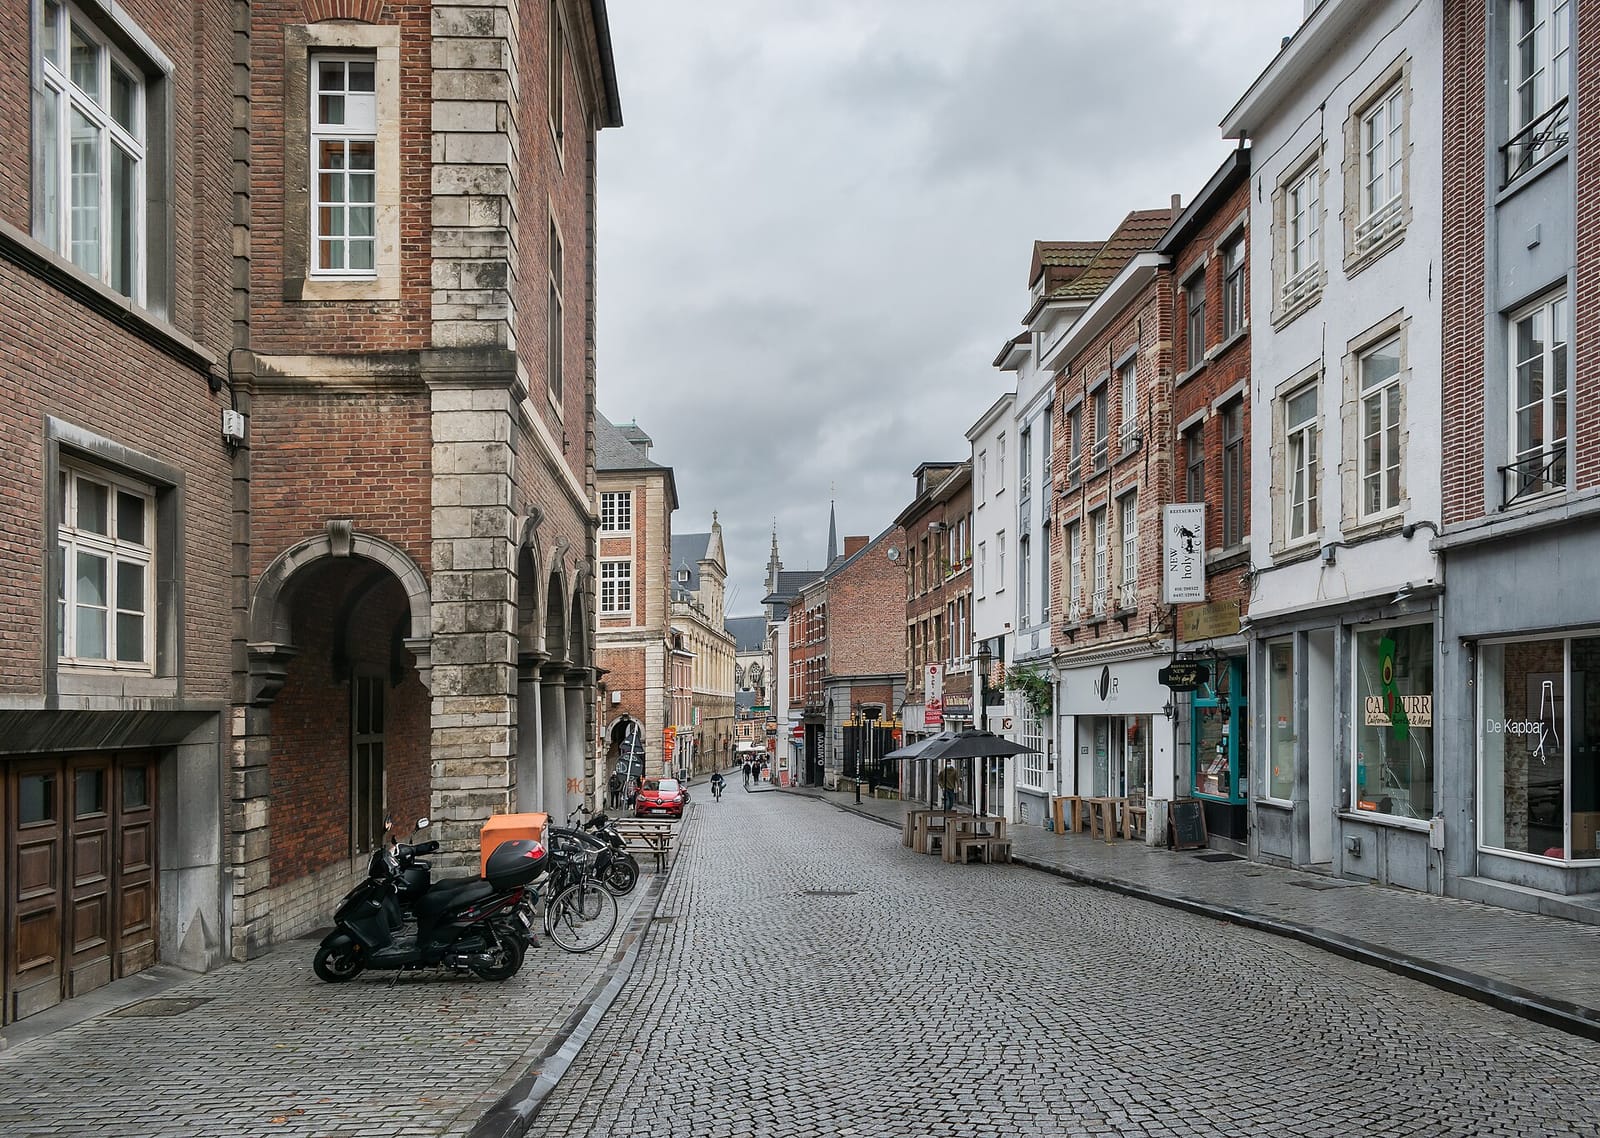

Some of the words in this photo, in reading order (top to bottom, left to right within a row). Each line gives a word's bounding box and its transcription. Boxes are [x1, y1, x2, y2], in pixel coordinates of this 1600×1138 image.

[1169, 548, 1179, 572] NEW
[1181, 555, 1195, 580] holy
[1486, 718, 1502, 733] De
[1503, 718, 1545, 737] Kapbar
